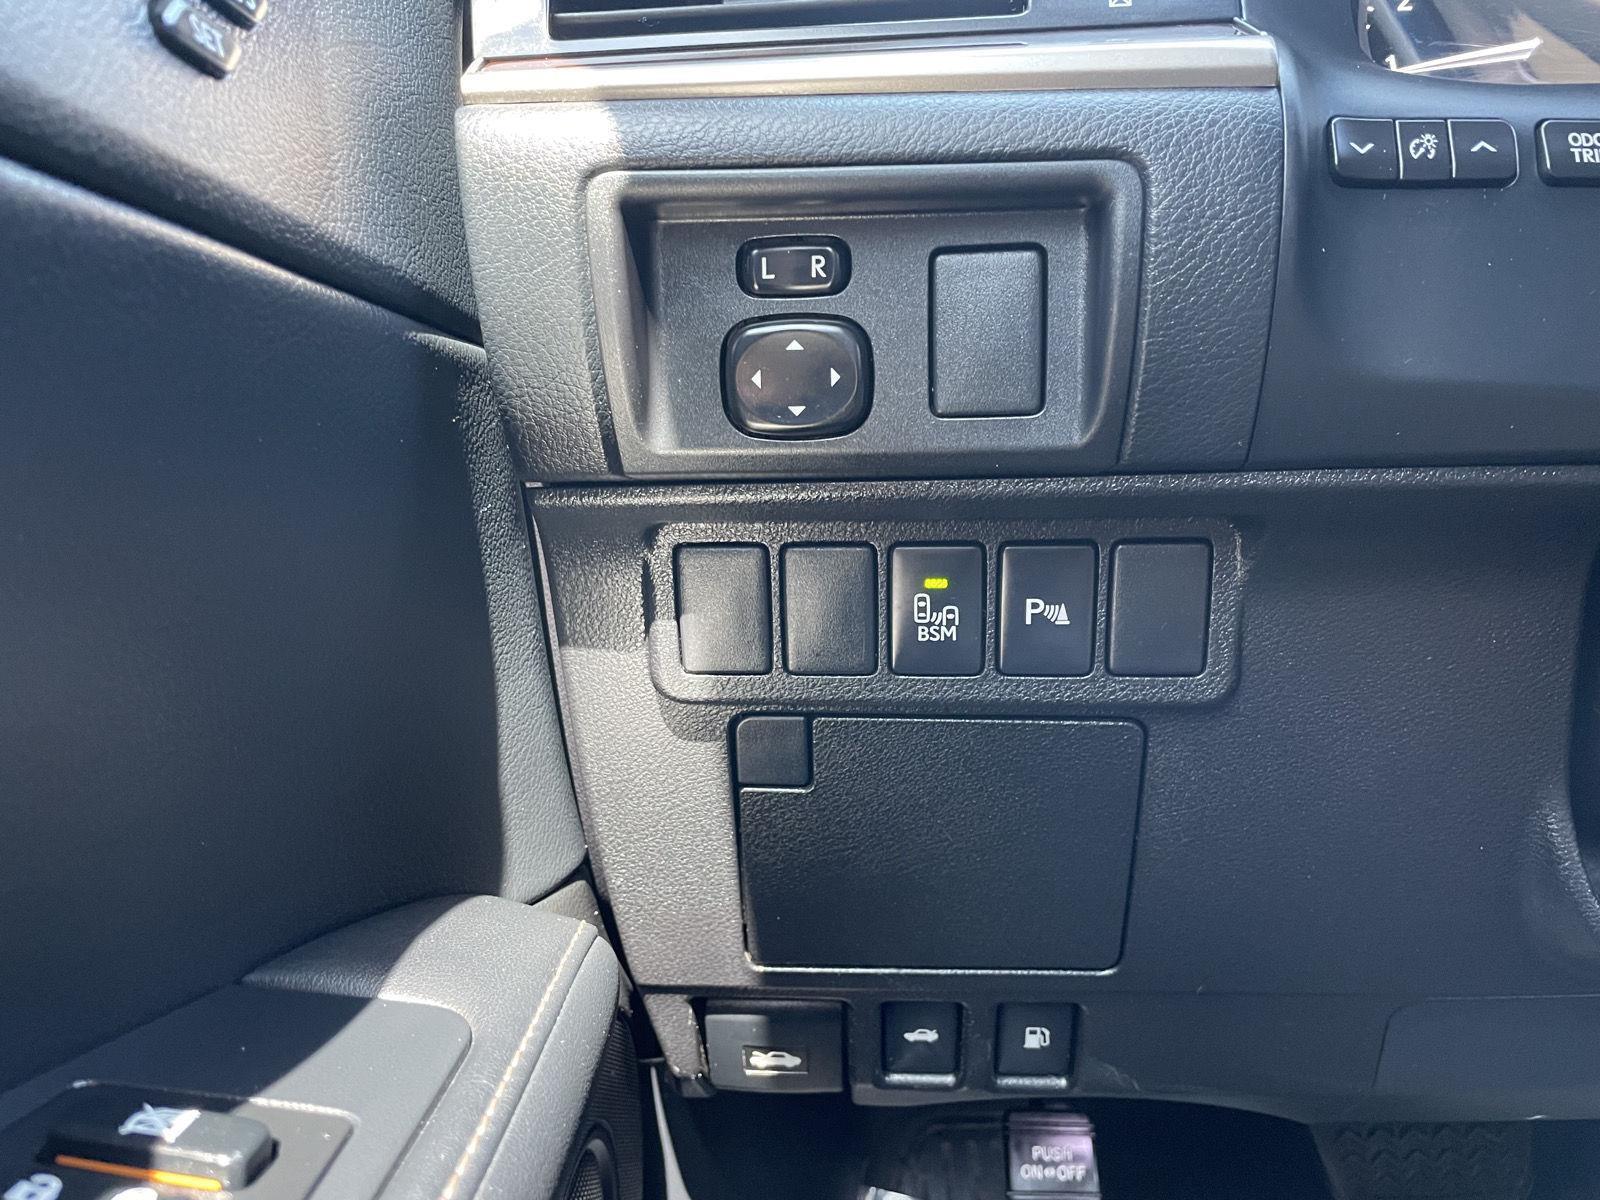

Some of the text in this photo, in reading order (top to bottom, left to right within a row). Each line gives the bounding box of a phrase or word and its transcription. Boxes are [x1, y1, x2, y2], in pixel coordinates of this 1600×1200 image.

[761, 255, 827, 279] L R
[1025, 598, 1045, 625] P
[917, 625, 957, 642] BSM
[1031, 1145, 1073, 1162] PUSH
[1020, 1163, 1087, 1182] ON OFF
